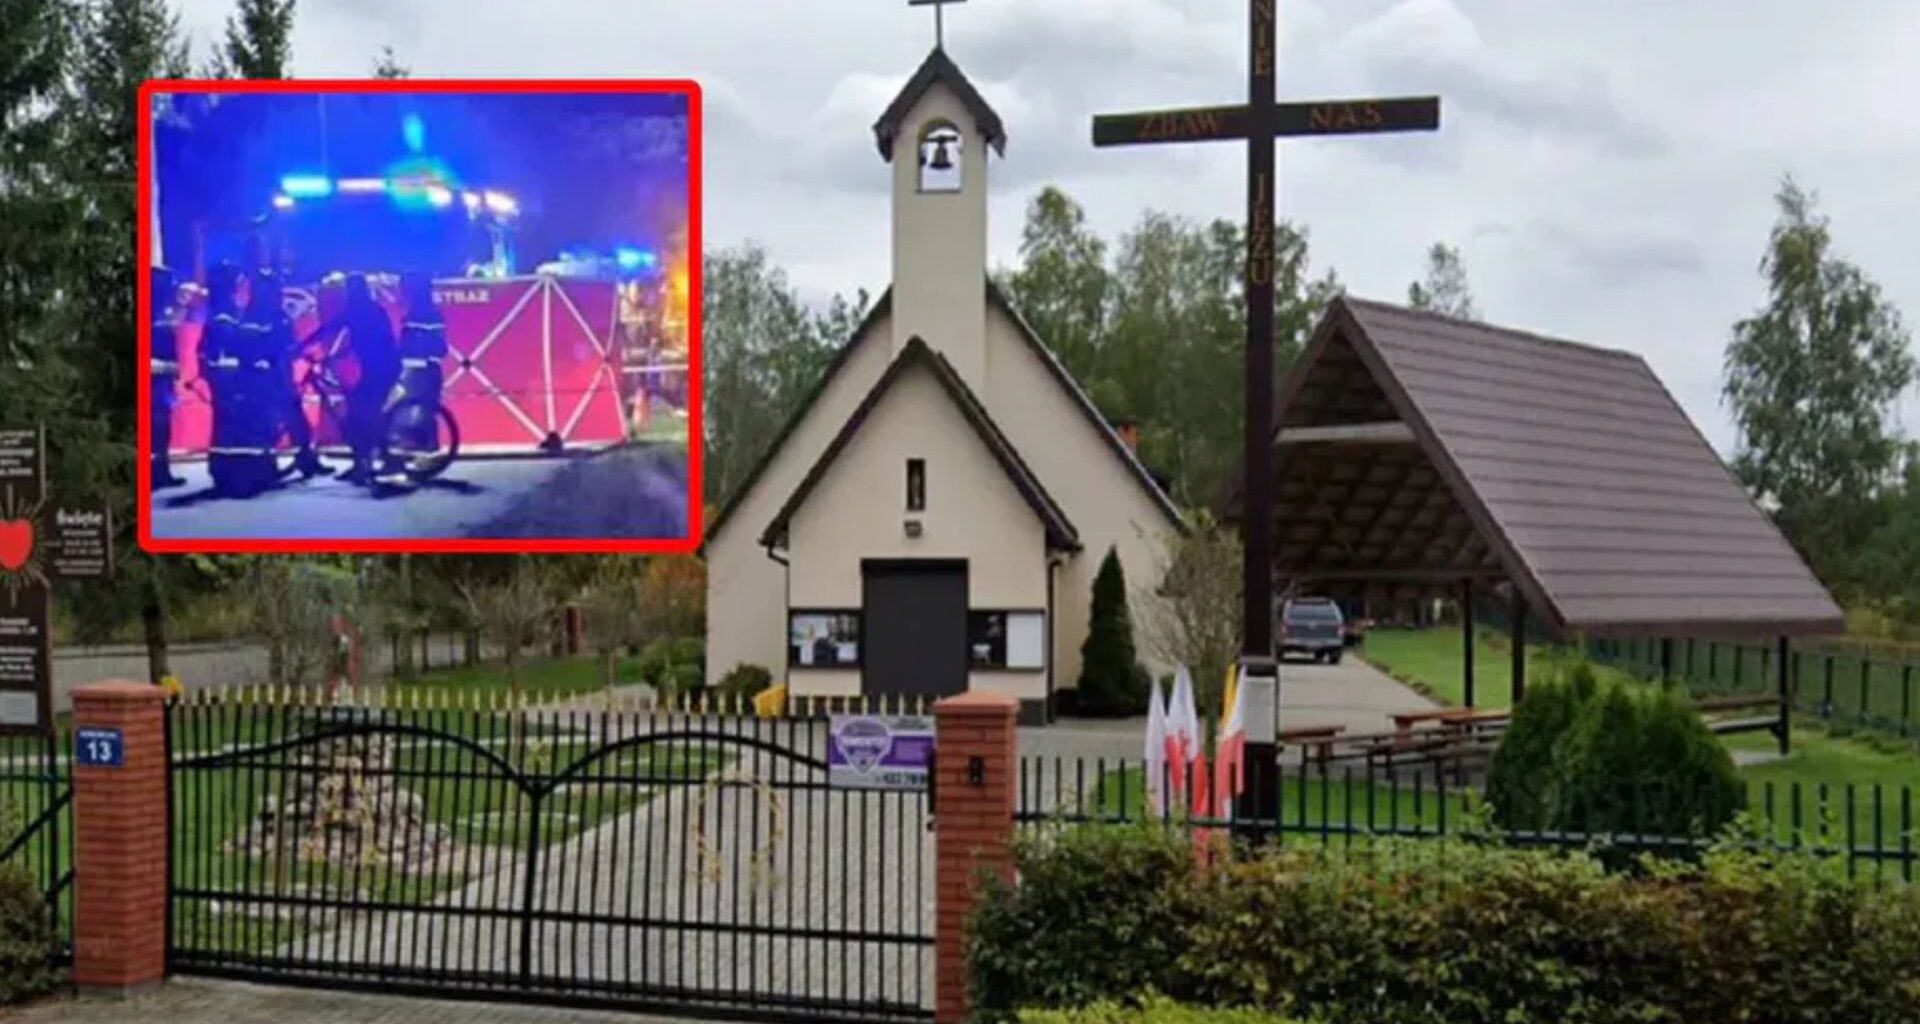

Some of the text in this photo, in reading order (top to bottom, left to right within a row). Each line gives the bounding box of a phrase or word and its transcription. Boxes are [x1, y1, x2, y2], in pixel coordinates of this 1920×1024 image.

[1138, 102, 1382, 138] ZBAW NAS
[1251, 173, 1272, 285] JEZU
[87, 740, 112, 762] 13
